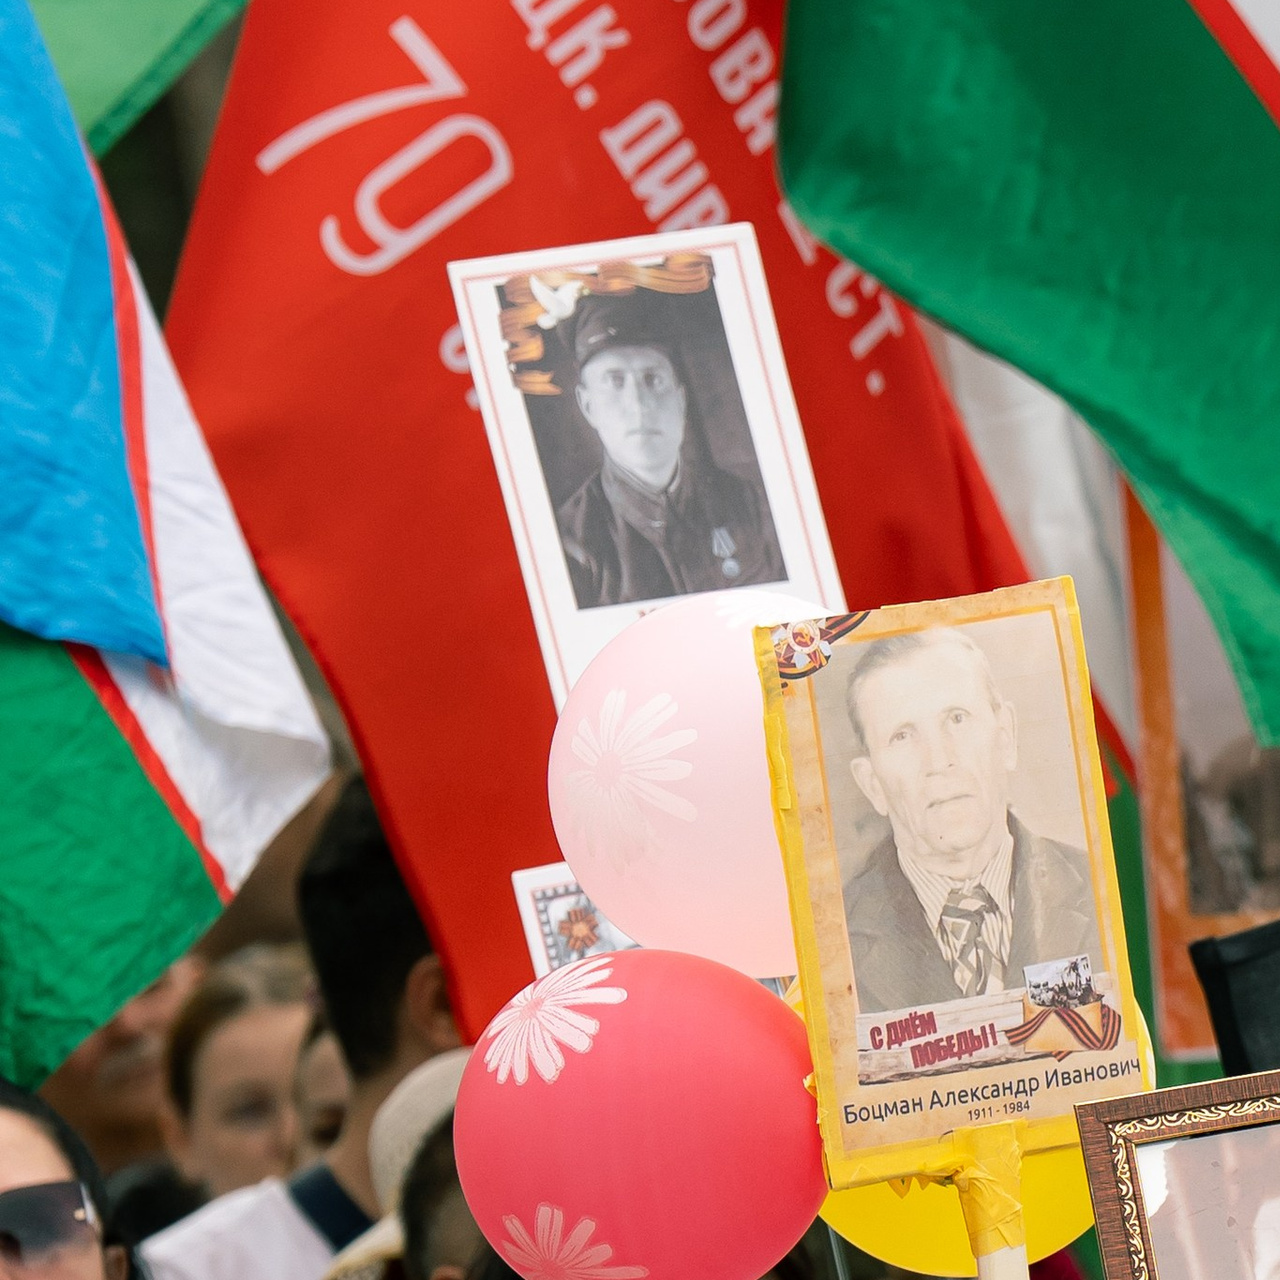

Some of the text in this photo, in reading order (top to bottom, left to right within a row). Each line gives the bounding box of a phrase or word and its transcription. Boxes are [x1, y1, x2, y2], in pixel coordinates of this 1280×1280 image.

[256, 14, 515, 278] 79
[870, 1026, 884, 1050] С
[843, 1057, 1141, 1125] Боцман Александр Иванович
[968, 1106, 993, 1121] 1911
[1004, 1099, 1031, 1117] 1984
